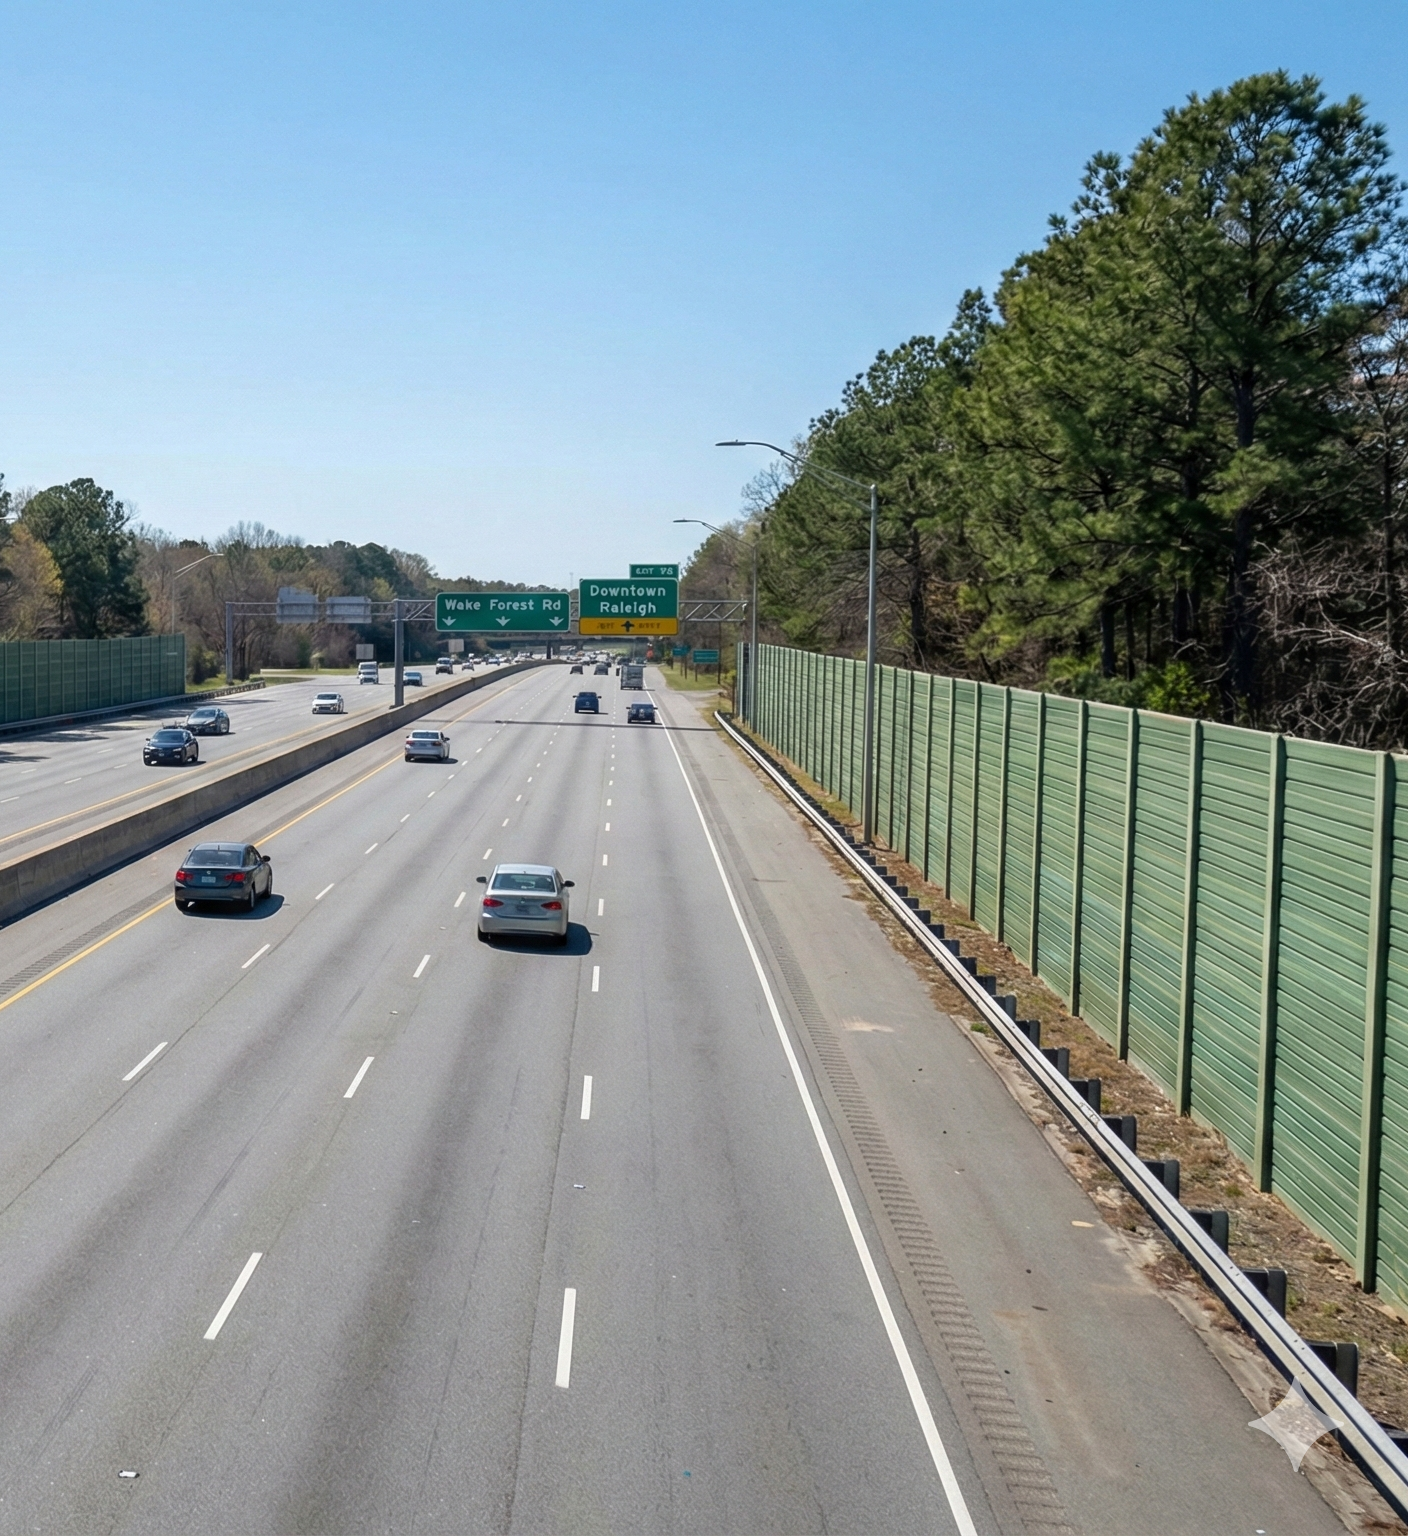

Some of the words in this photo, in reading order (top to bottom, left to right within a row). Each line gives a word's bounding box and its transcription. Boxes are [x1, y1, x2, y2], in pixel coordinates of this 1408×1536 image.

[590, 584, 666, 597] Downtown
[445, 599, 481, 610] Wake
[489, 599, 534, 610] Forest
[542, 599, 561, 610] Rd
[600, 601, 656, 617] Raleigh
